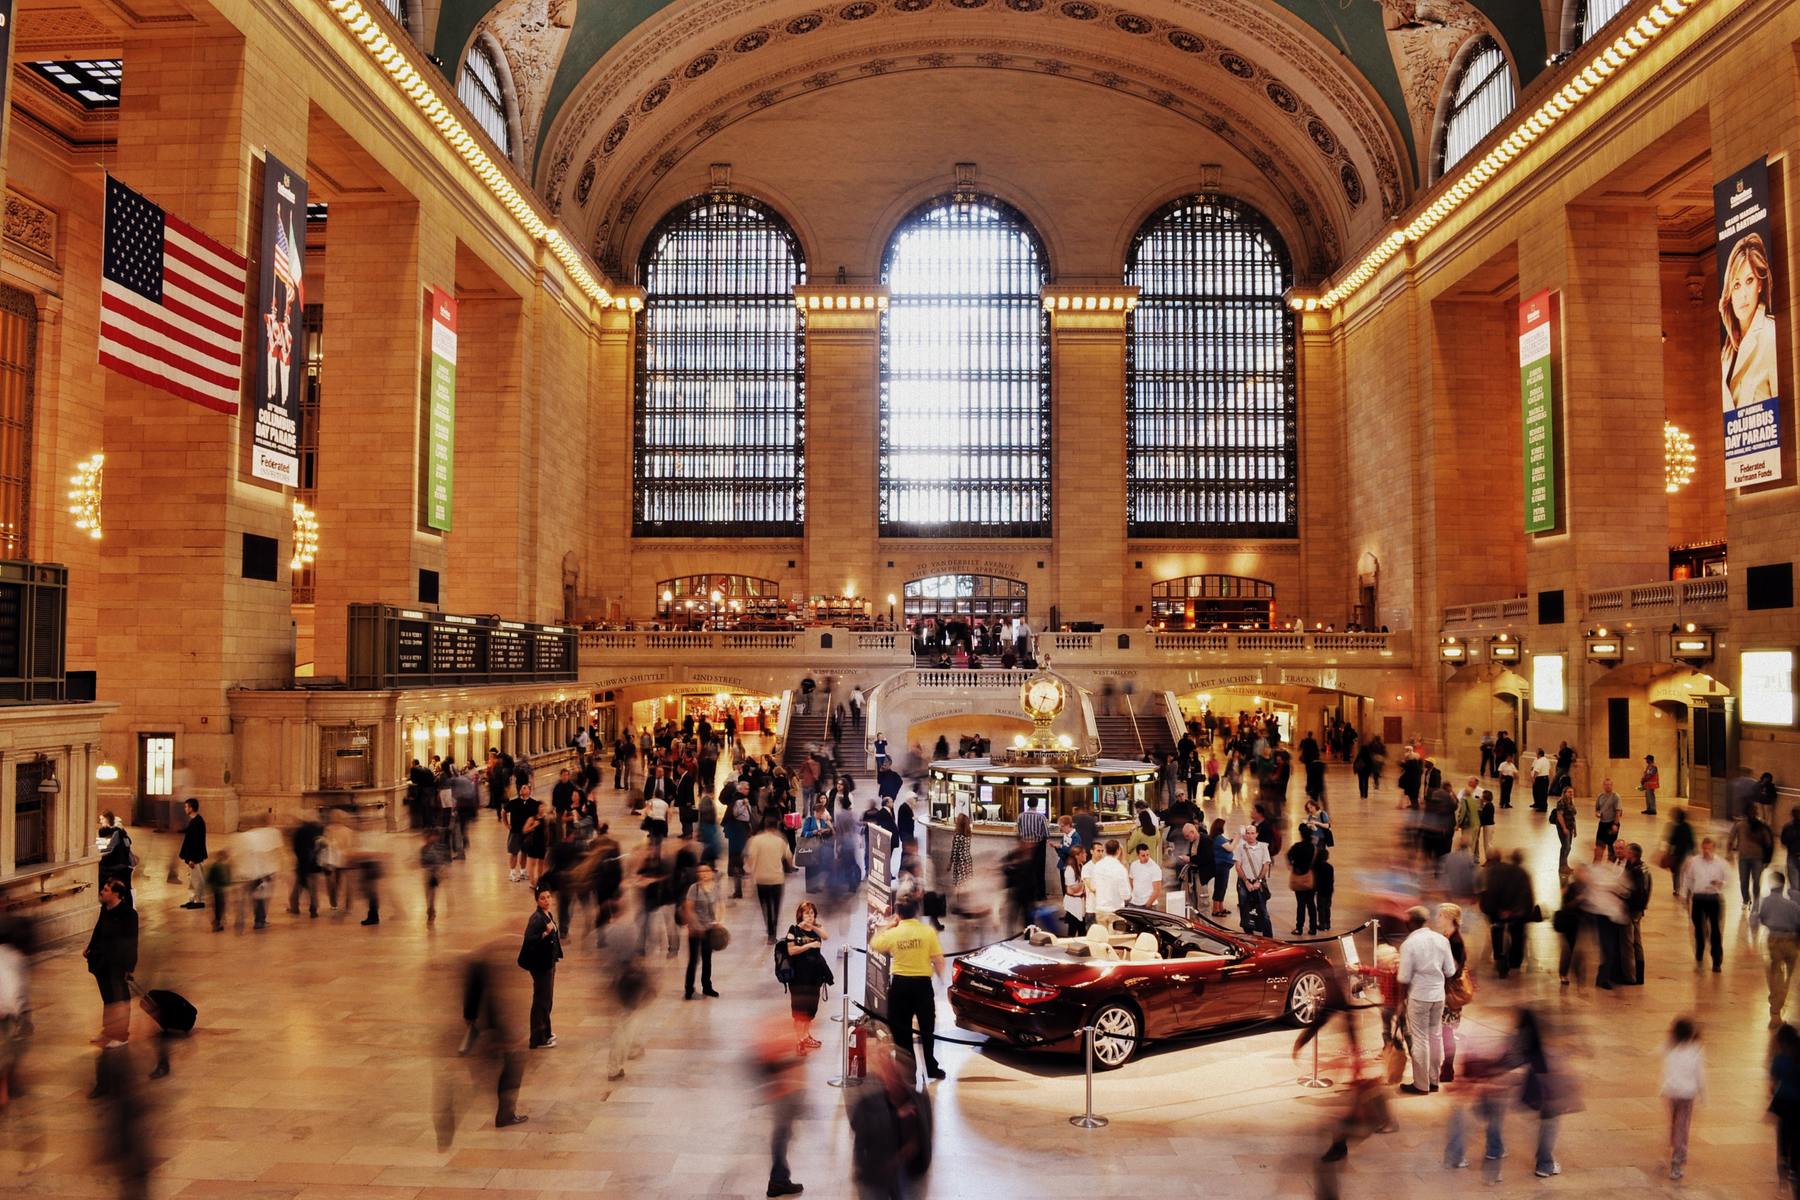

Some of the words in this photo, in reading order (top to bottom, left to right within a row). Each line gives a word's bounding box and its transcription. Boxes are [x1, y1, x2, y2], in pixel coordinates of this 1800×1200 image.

[259, 408, 296, 433] COLUMBUS
[1727, 410, 1774, 435] COLUMBUS
[256, 422, 270, 439] DAY
[270, 427, 296, 449] PARADE
[1725, 433, 1741, 450] DAY
[1742, 424, 1777, 446] PARADE
[261, 455, 290, 473] Federated
[1740, 461, 1765, 473] Federated
[1758, 469, 1772, 478] Funds
[984, 561, 1015, 570] AVENUE
[930, 566, 971, 574] CAMPBELL
[975, 567, 1021, 578] APARTMENT
[595, 676, 628, 688] SUBWAY
[630, 673, 665, 682] SHUTTLE
[692, 673, 713, 682] 42ND
[714, 675, 743, 686] STREET
[1189, 680, 1216, 690] TICKET
[1218, 675, 1258, 685] MACHINES
[1286, 675, 1316, 684] TRACKS
[672, 686, 698, 694] SUBWAY
[1258, 689, 1278, 698] ROOM
[1033, 751, 1069, 759] Information
[897, 939, 923, 950] SECURITY
